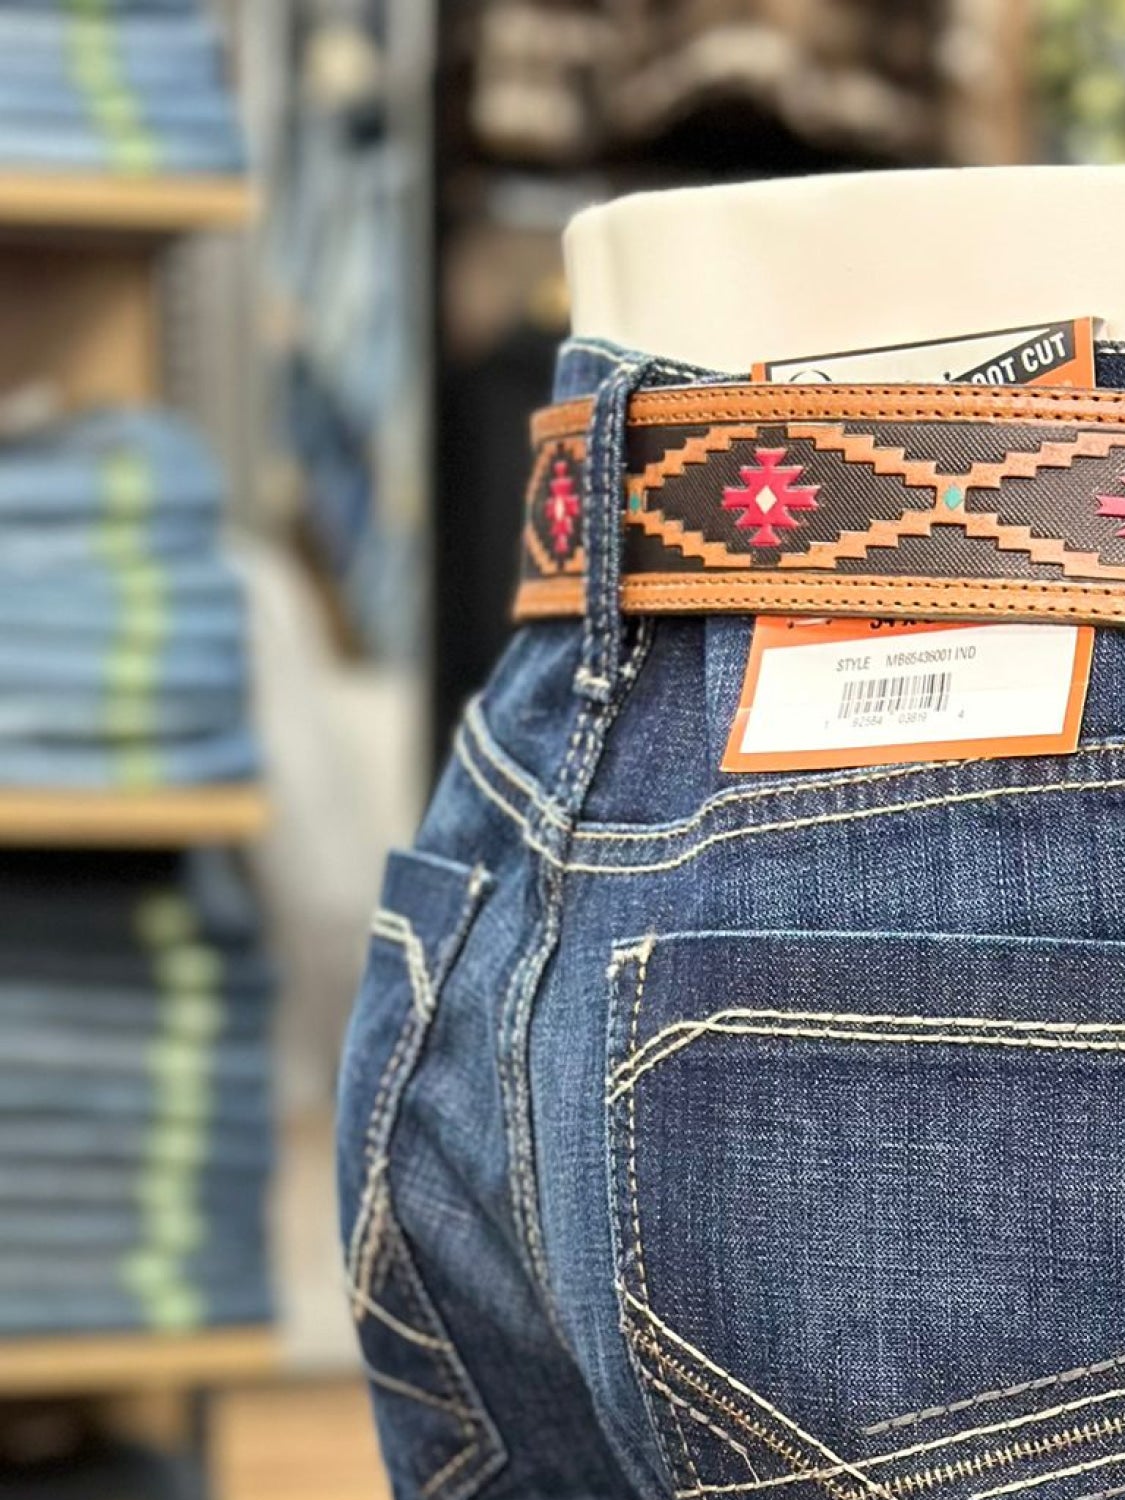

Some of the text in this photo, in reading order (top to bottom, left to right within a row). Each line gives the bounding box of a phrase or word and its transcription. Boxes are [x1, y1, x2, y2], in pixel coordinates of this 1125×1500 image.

[1021, 331, 1066, 373] CUT
[836, 656, 871, 672] STYLE
[955, 645, 977, 660] IND
